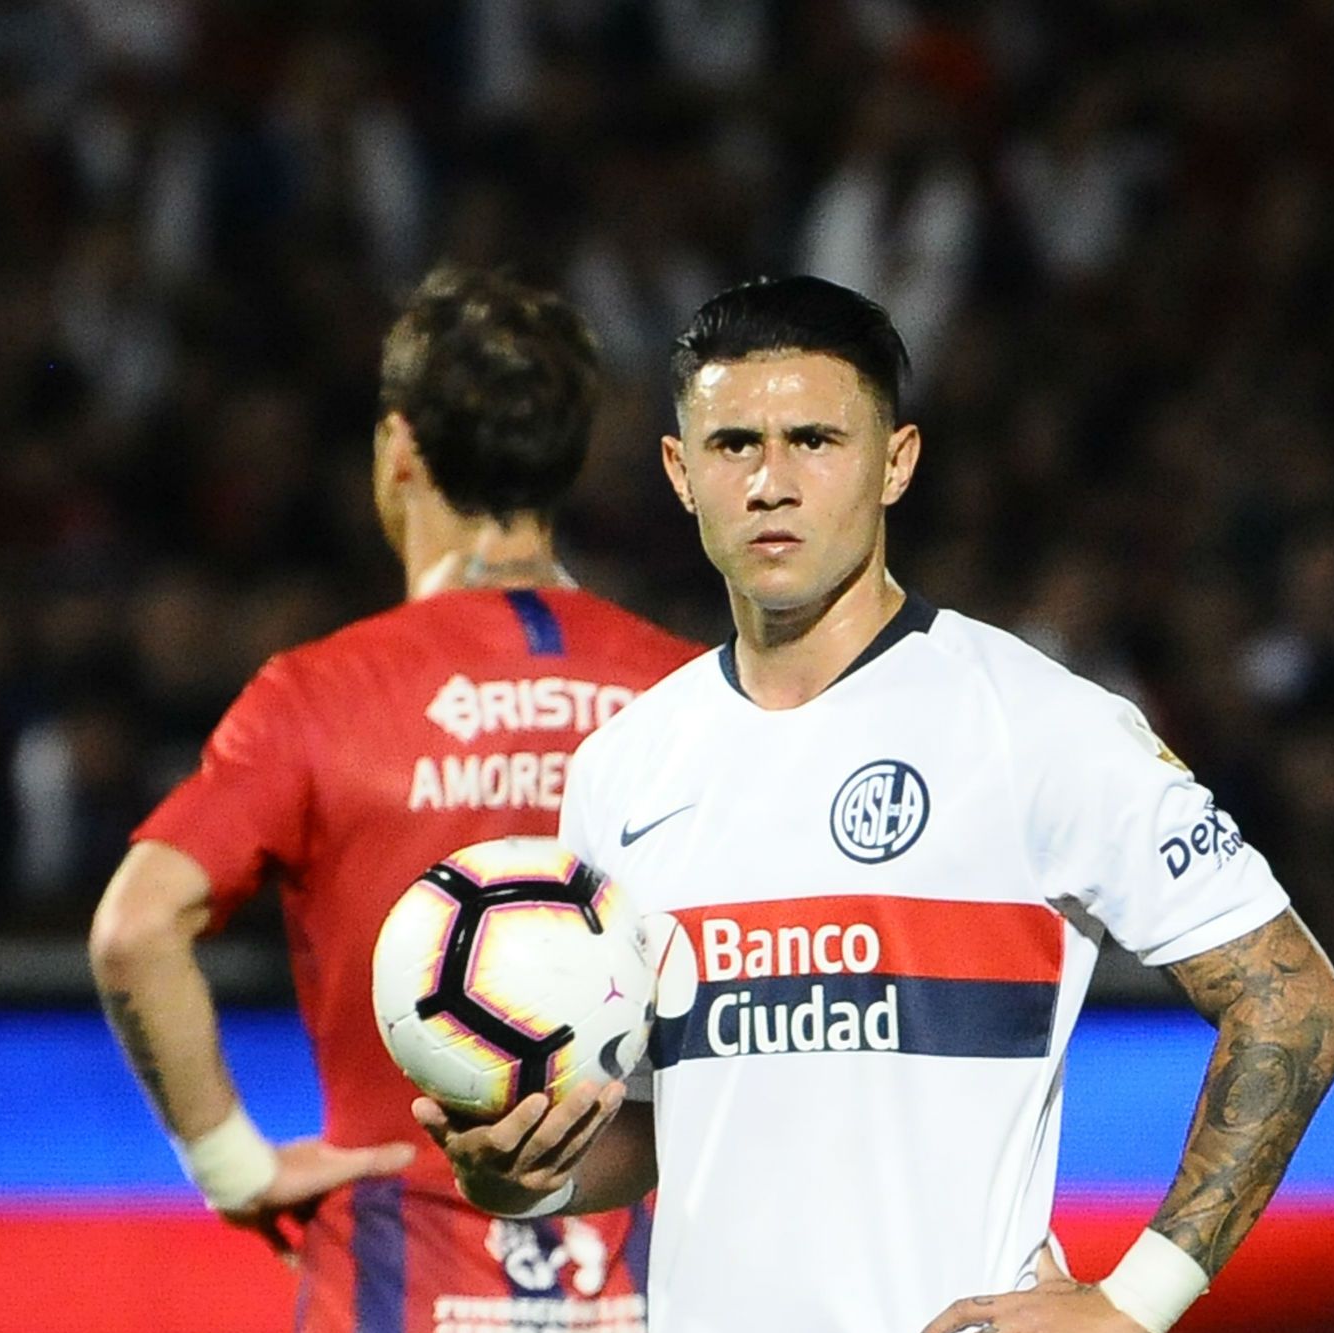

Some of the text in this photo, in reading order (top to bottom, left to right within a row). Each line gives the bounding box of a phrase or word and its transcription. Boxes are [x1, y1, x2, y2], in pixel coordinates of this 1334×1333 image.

[424, 673, 645, 745] BRISTO
[408, 752, 572, 811] AMORE
[702, 918, 880, 982] Banco
[707, 984, 899, 1056] Ciudad
